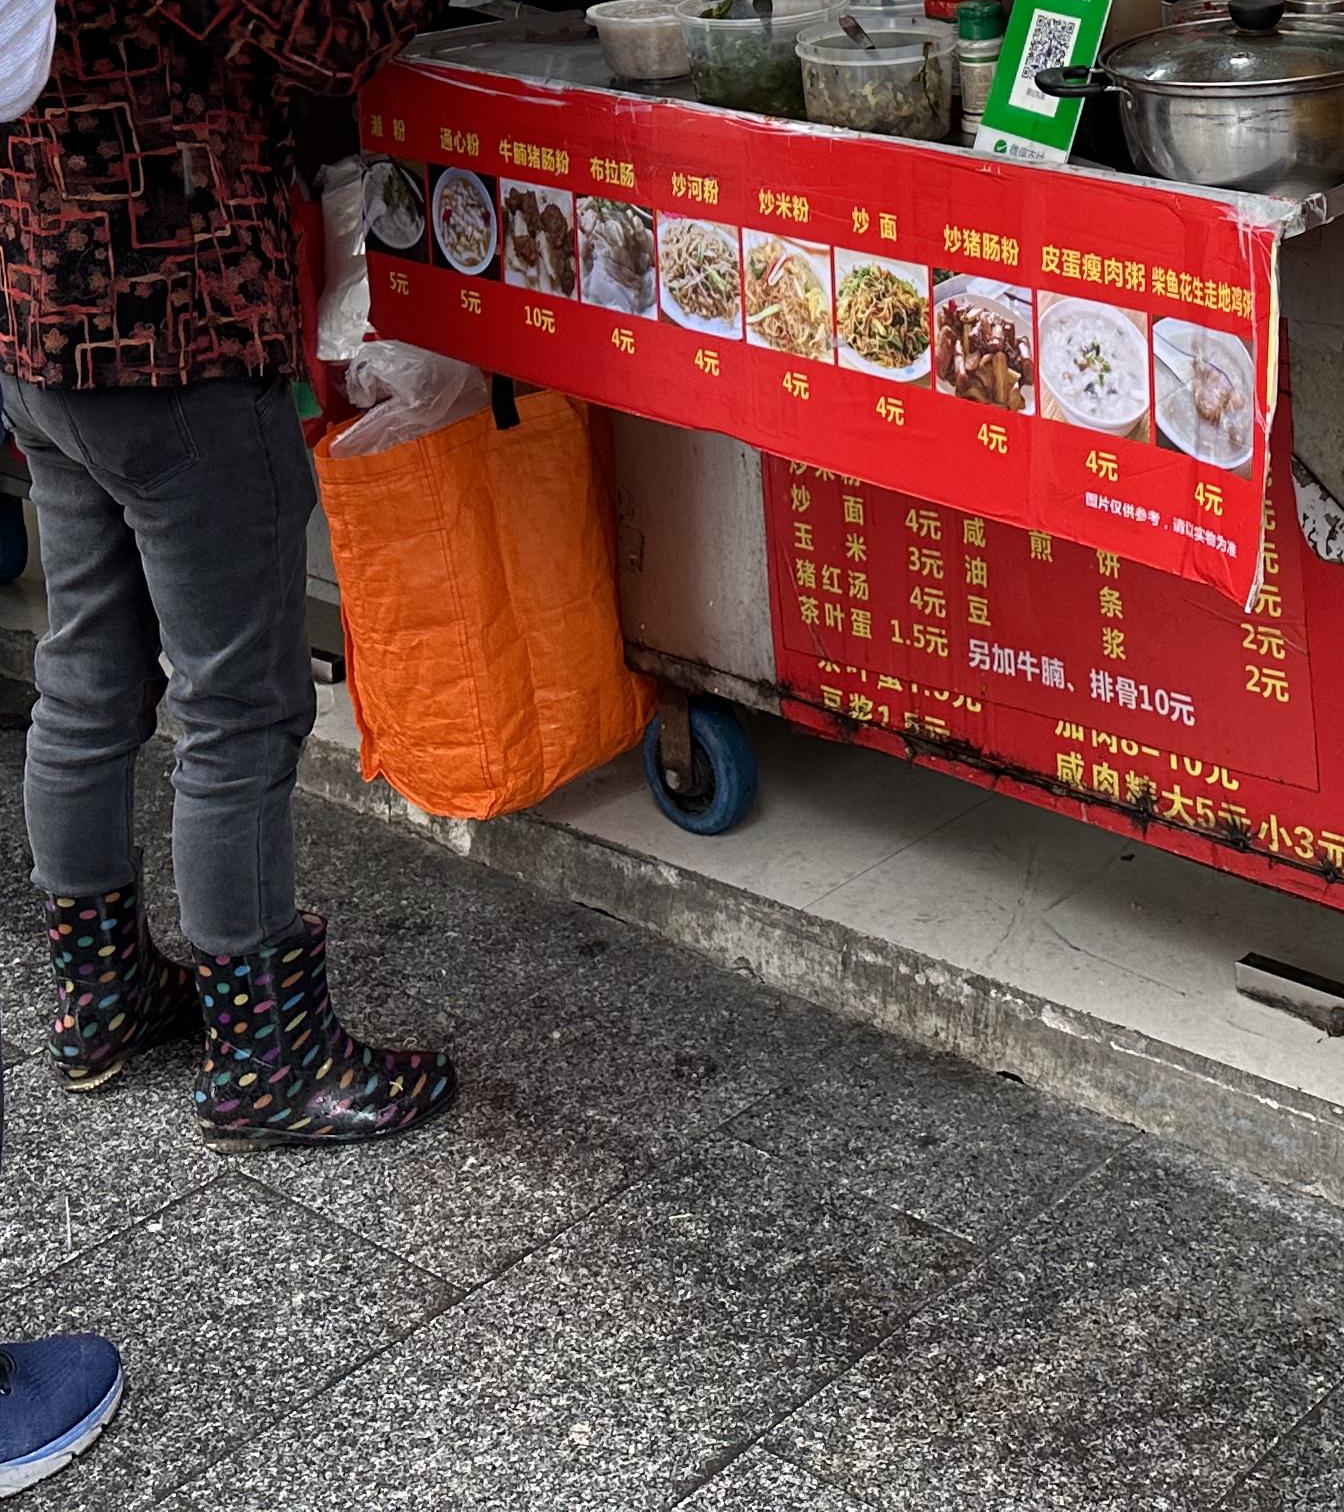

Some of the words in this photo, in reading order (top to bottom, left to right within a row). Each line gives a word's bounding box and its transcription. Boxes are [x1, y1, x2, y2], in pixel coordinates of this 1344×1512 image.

[439, 127, 480, 156] 通心粉
[498, 138, 570, 176] 牛腩猪肠粉
[589, 155, 635, 188] 布拉肠
[671, 172, 719, 206] 炒河粉
[758, 188, 809, 223] 炒米粉
[942, 223, 1020, 267] 炒猪肠粉
[389, 271, 410, 296] 5元
[1041, 244, 1147, 293] 皮蛋瘦肉粥
[460, 289, 482, 315] 5元
[524, 304, 556, 334] 10元
[611, 327, 636, 354] 4元
[694, 348, 721, 376] 4元
[783, 371, 810, 400] 4元
[875, 395, 905, 426] 4元
[976, 423, 1009, 455] 4元
[1085, 450, 1119, 482] 4元
[1193, 481, 1224, 517] 4元
[905, 508, 942, 541] 4元
[908, 546, 944, 580] 3元
[909, 586, 946, 619] 4元
[798, 595, 872, 640] 茶叶蛋
[890, 619, 949, 658] 1.5元
[1241, 622, 1287, 660] 2元
[968, 639, 1196, 727] 另加牛腩、排骨10元
[1246, 664, 1290, 703] 2元
